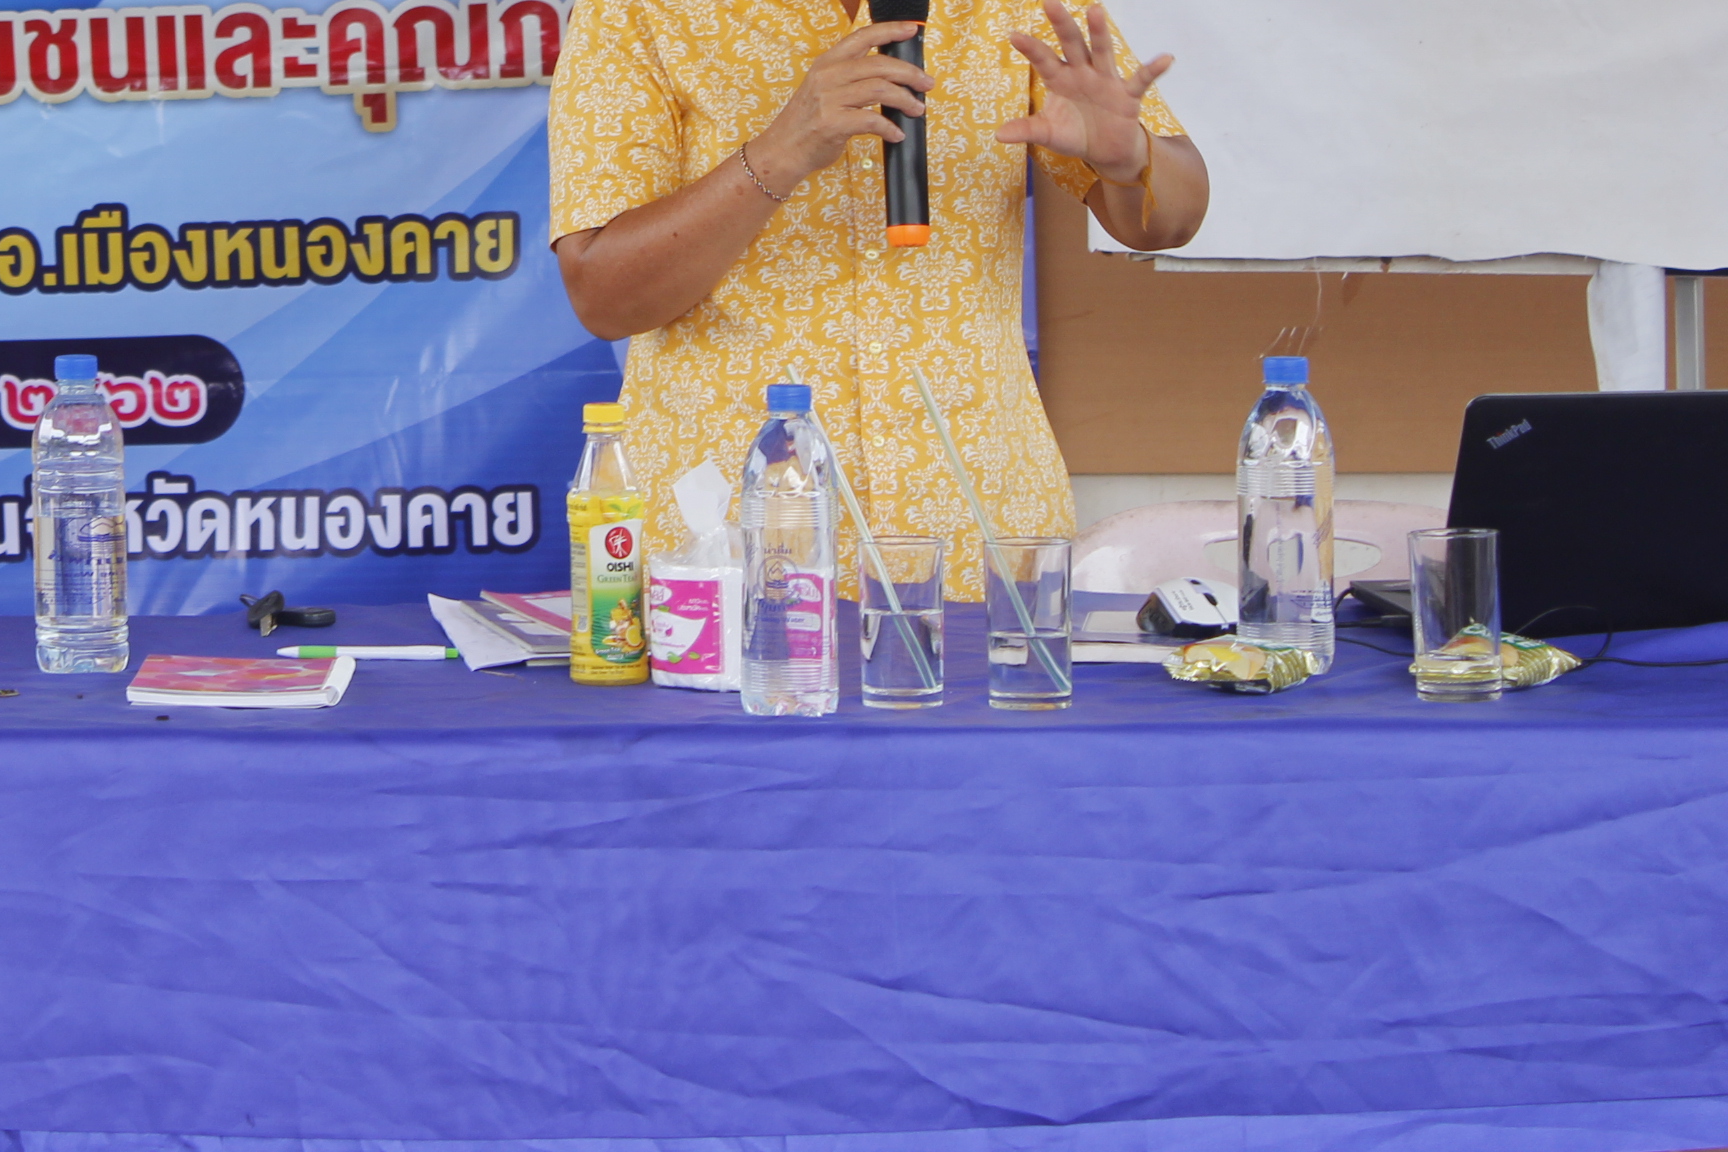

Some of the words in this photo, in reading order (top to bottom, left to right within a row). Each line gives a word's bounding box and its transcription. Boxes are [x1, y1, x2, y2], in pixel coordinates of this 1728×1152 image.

[0, 372, 205, 428] ๒๖๒
[1486, 418, 1532, 449] ThinkPad
[606, 562, 634, 572] OISHI
